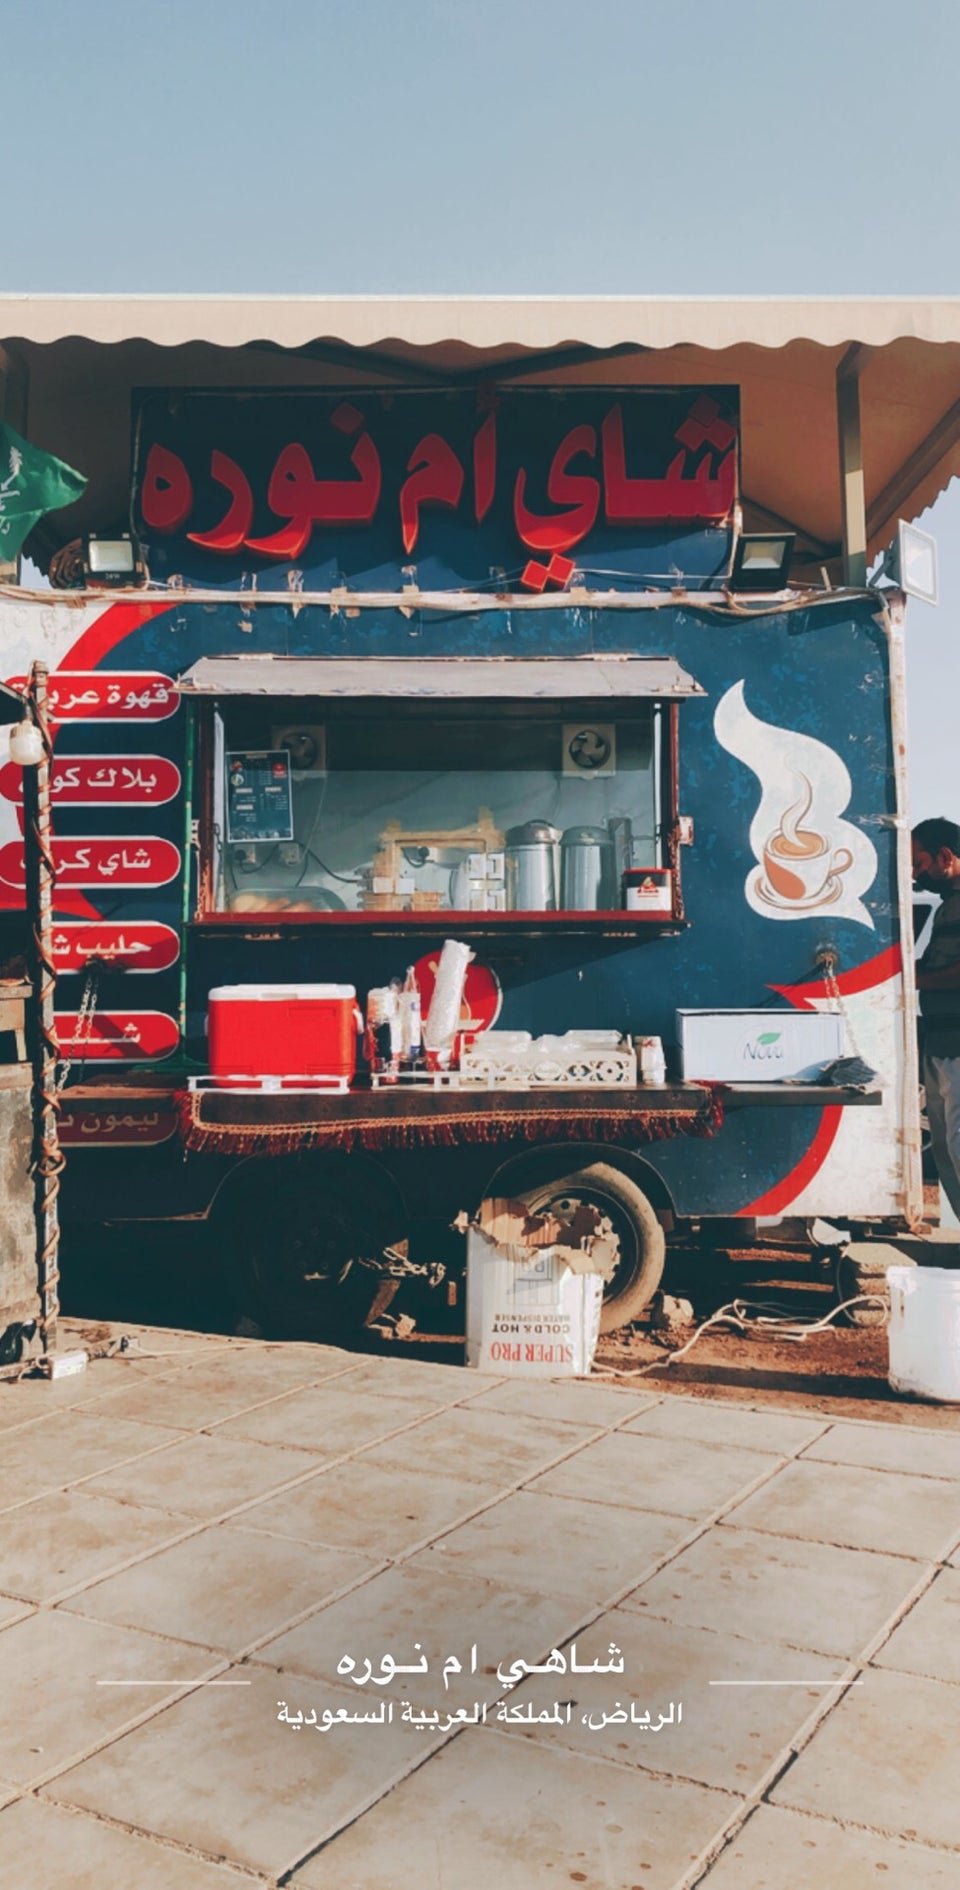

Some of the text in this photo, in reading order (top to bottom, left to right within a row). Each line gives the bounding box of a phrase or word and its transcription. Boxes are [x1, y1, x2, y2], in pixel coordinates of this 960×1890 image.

[142, 401, 382, 559] نوره
[514, 393, 738, 591] شاي
[107, 683, 170, 709] قهوة
[87, 767, 157, 793] بلاك
[97, 848, 151, 876] شاي
[76, 934, 152, 960] حليب
[491, 1324, 571, 1334] COLD & HOT
[494, 1313, 542, 1322] DISPENSER
[490, 1341, 574, 1364] SUPER PRO
